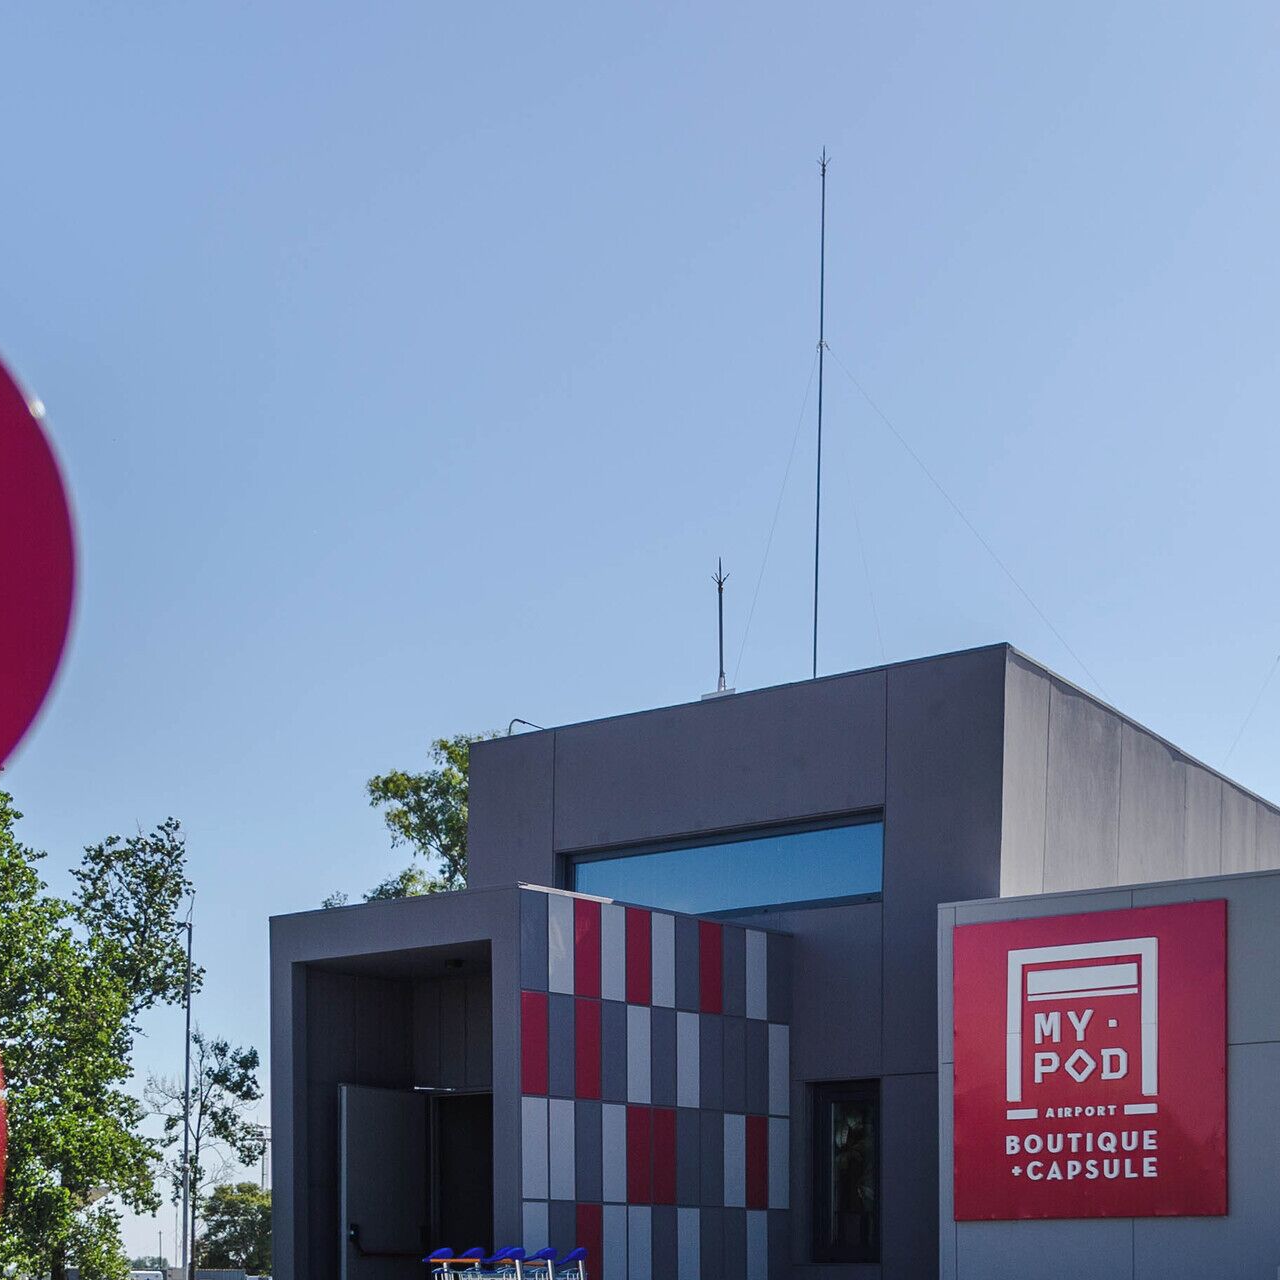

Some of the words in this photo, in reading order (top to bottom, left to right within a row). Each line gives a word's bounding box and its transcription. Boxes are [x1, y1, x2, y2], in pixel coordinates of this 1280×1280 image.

[1034, 1009, 1093, 1043] MY
[1034, 1048, 1128, 1083] POD
[1045, 1104, 1117, 1118] AIRPORT
[1005, 1129, 1158, 1155] BOUTIQUE
